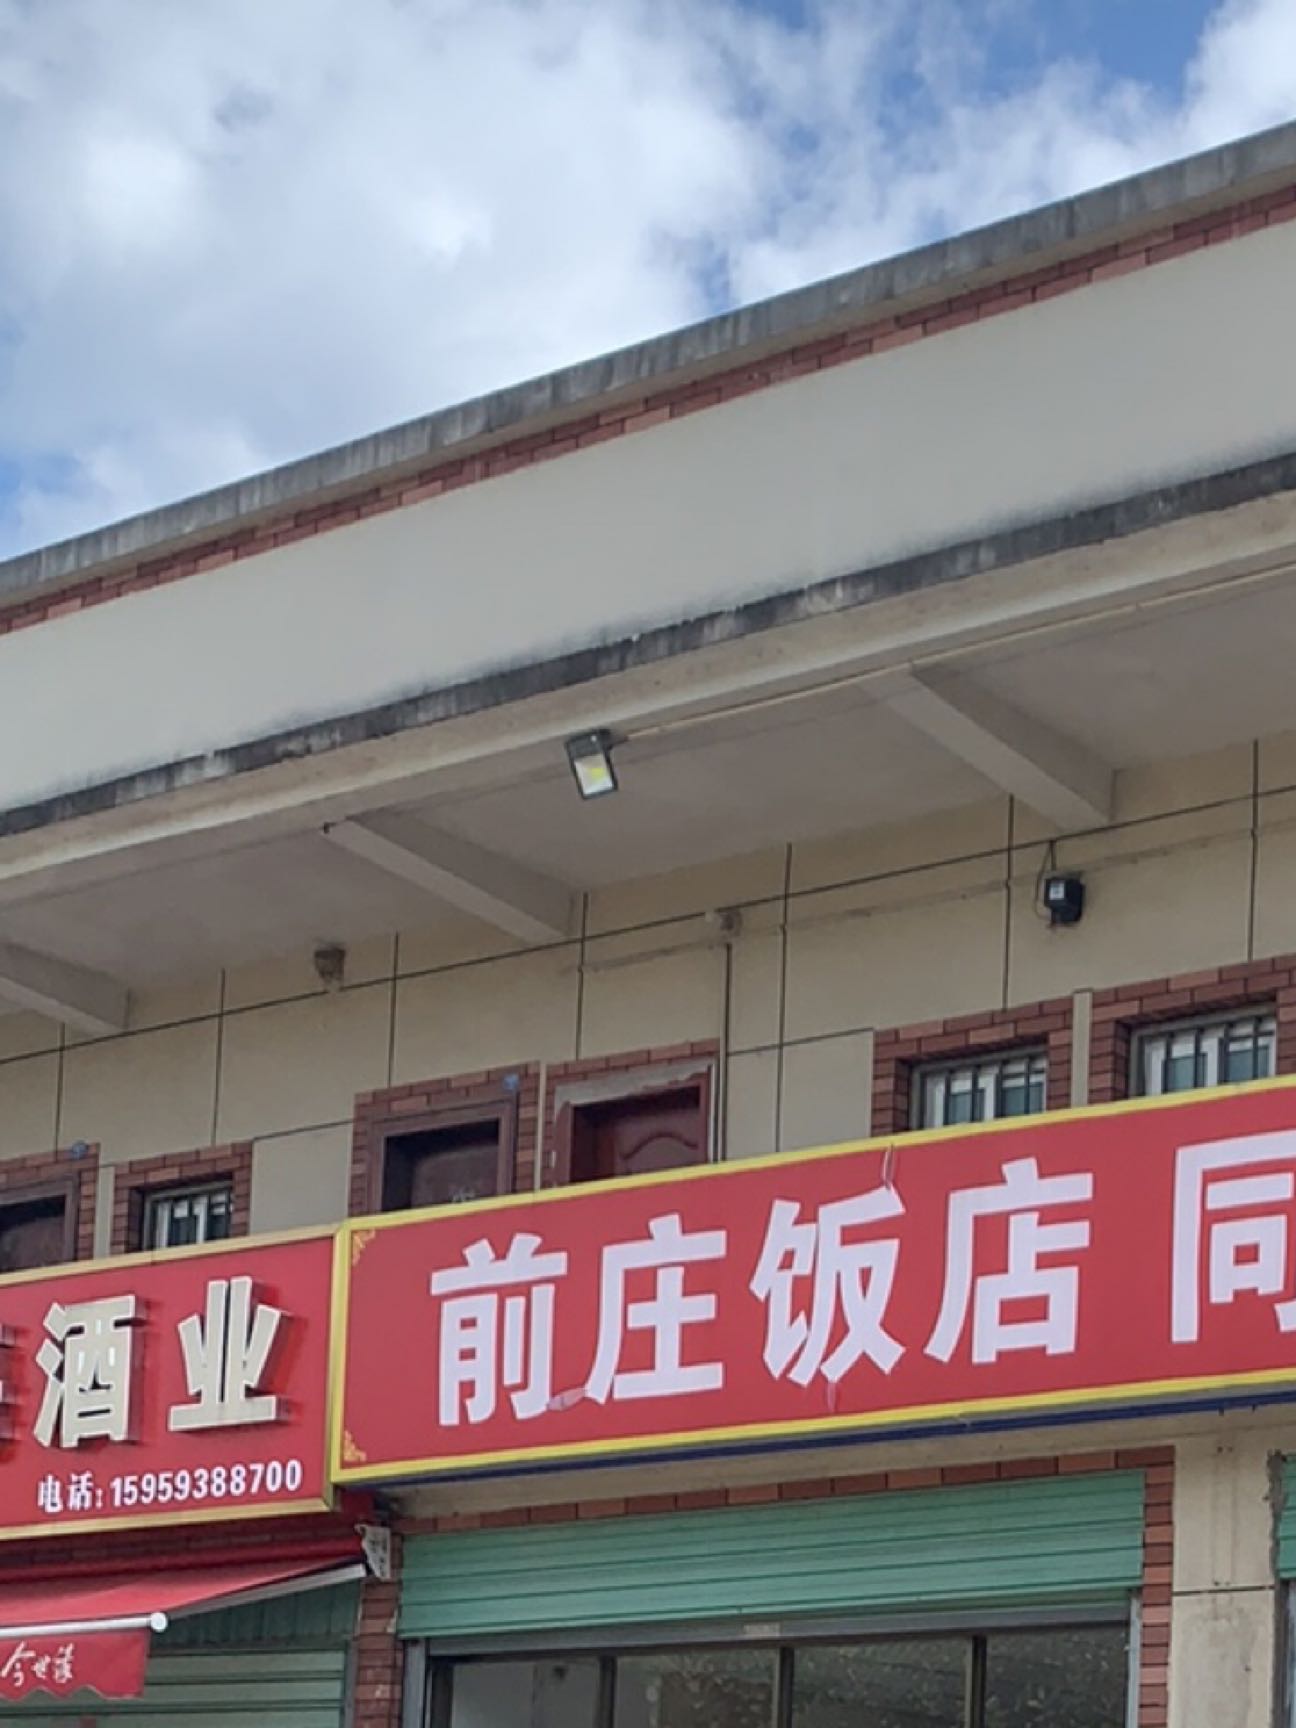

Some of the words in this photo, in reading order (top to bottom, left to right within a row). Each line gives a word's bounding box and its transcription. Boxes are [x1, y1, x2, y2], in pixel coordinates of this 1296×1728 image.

[0, 1276, 282, 1448] 酒业
[430, 1157, 1093, 1426] 前庄饭店
